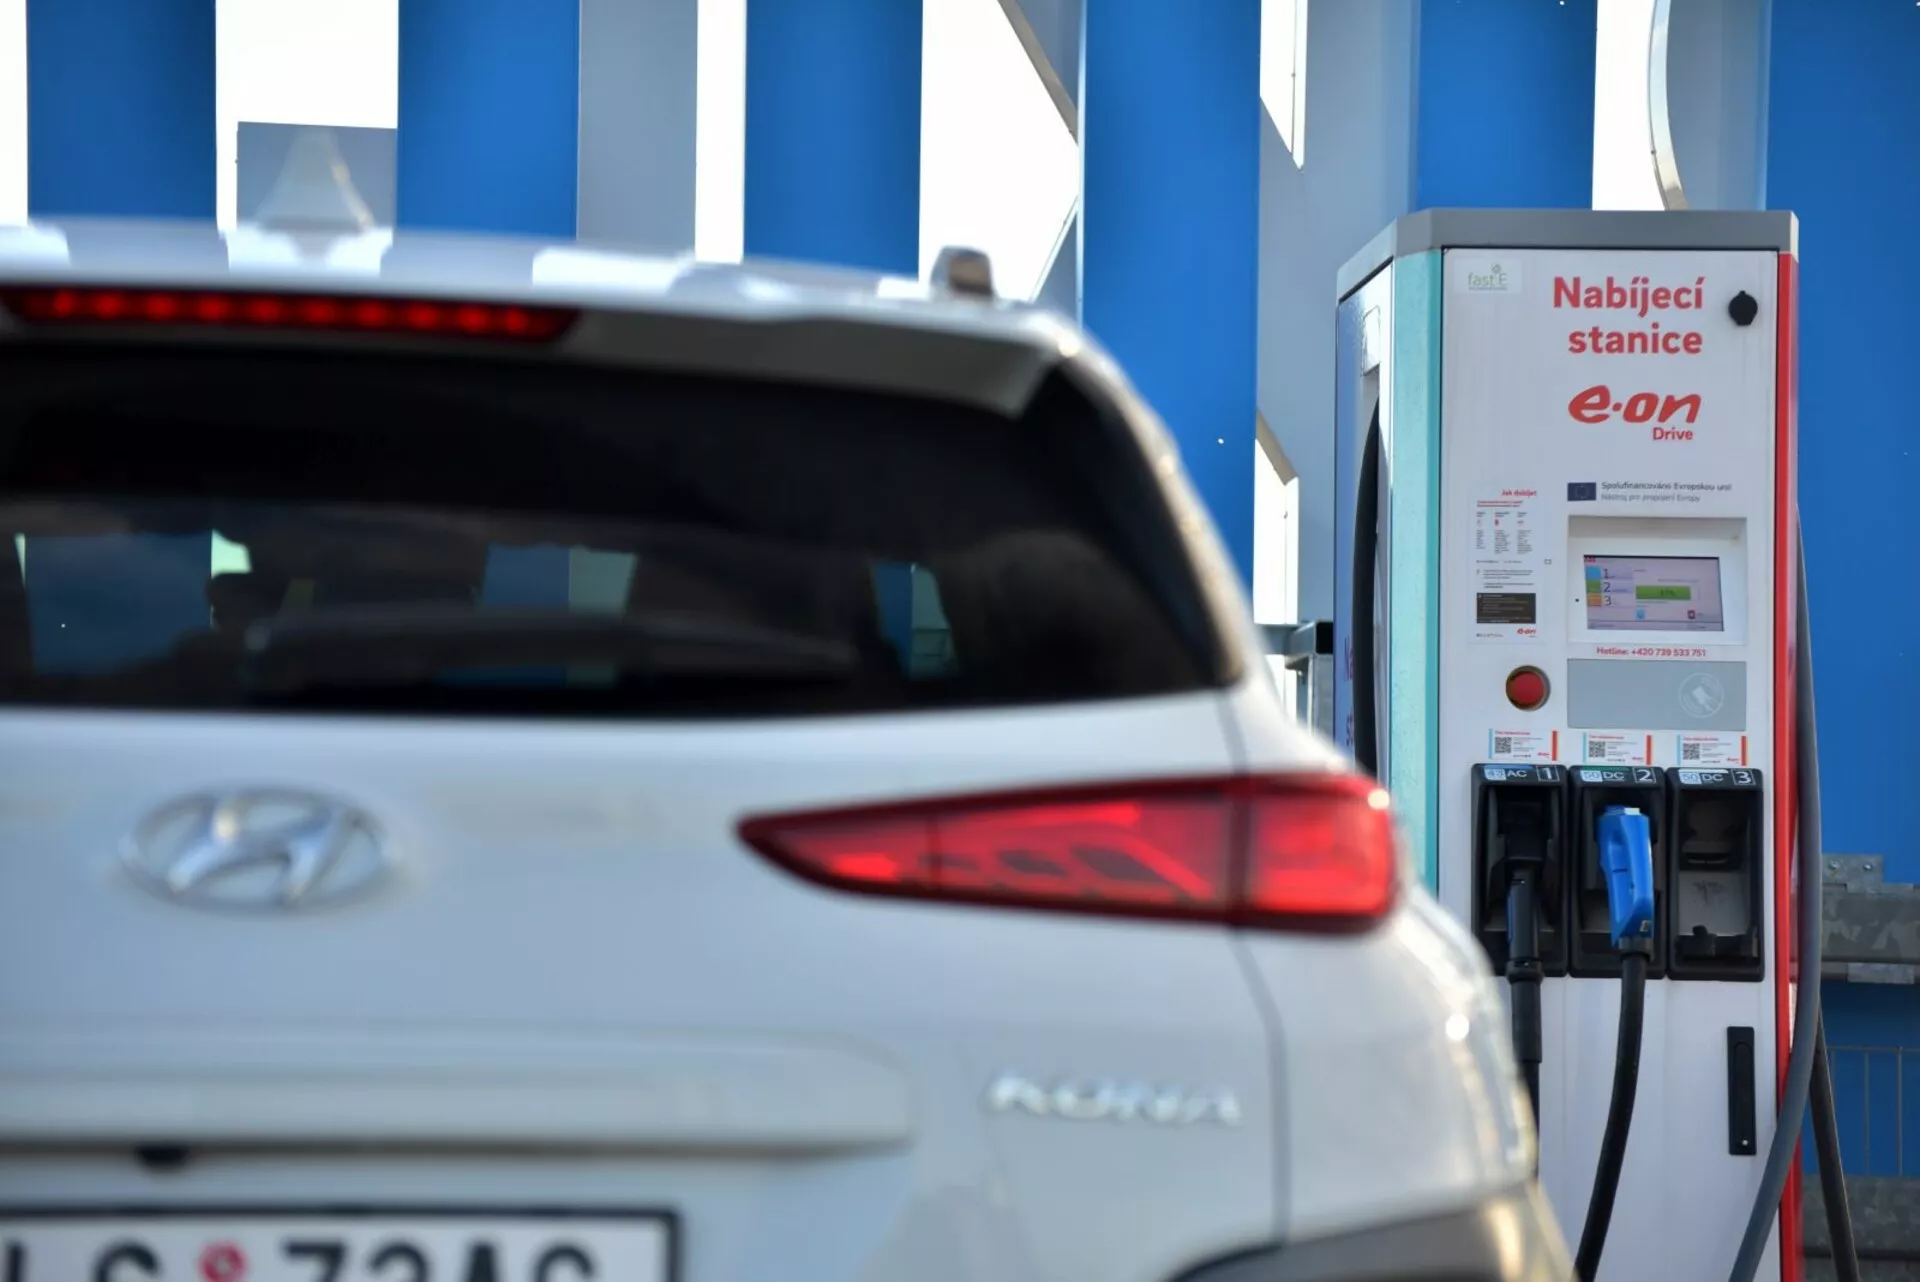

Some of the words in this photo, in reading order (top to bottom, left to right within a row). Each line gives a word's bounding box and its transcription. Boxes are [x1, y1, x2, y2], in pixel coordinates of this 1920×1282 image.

[1553, 276, 1705, 317] Nabíjecí
[1569, 323, 1703, 354] stanice
[1652, 426, 1694, 440] Drive
[1603, 568, 1609, 579] 1
[1603, 582, 1611, 593] 2
[1604, 595, 1612, 606] 3
[1597, 646, 1628, 655] Hotline:
[1632, 647, 1653, 656] +420
[1507, 769, 1528, 778] AC
[1541, 767, 1553, 780] 1
[1603, 771, 1625, 780] DC
[1638, 769, 1651, 781] 2
[1702, 773, 1724, 782] DC
[1737, 771, 1751, 784] 3
